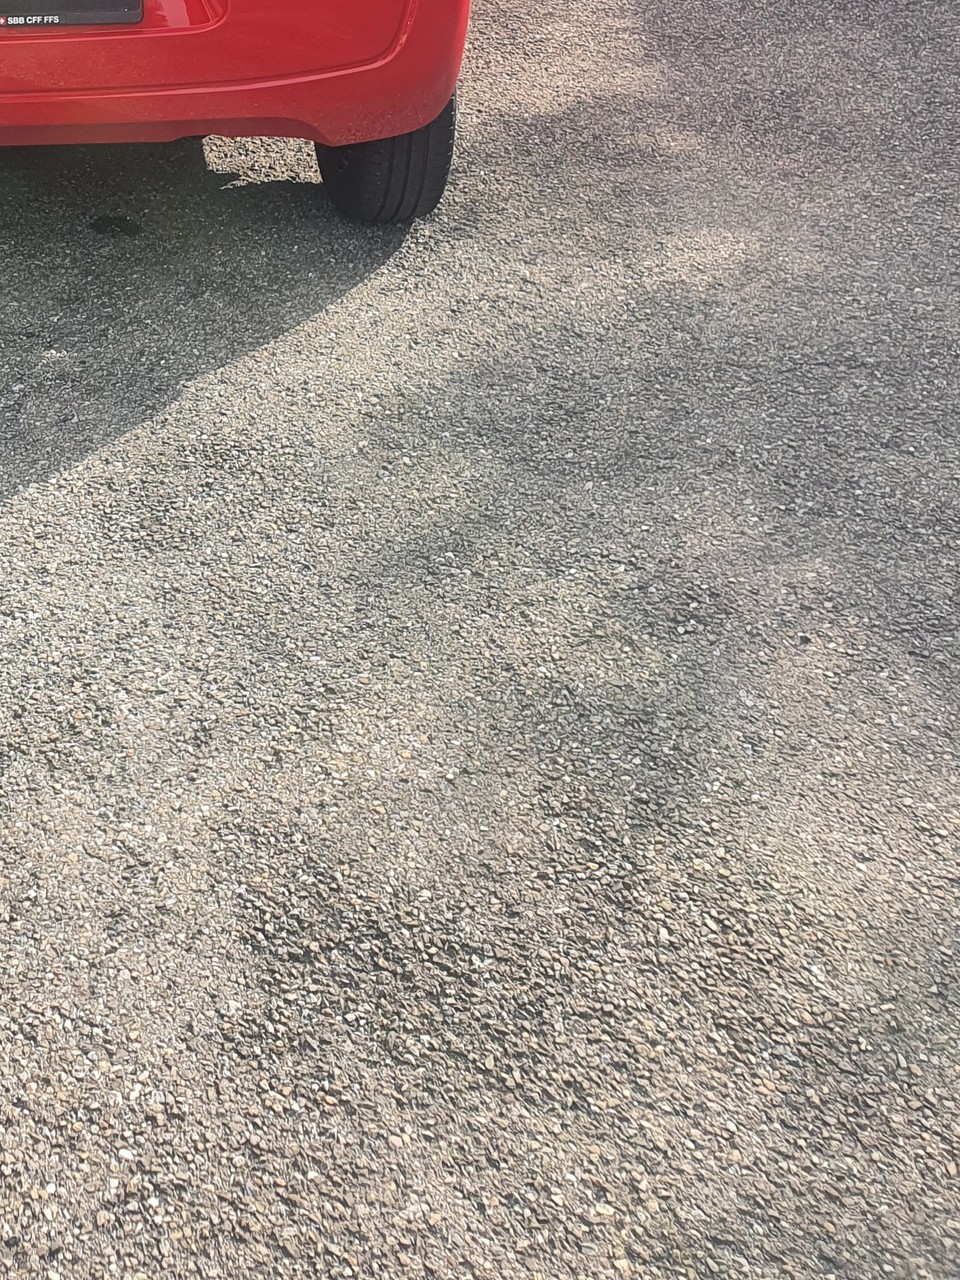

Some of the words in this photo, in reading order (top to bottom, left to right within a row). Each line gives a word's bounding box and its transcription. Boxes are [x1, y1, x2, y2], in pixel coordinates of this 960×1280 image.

[7, 16, 25, 25] SBB
[26, 16, 43, 24] CFF
[44, 15, 60, 24] FFS
